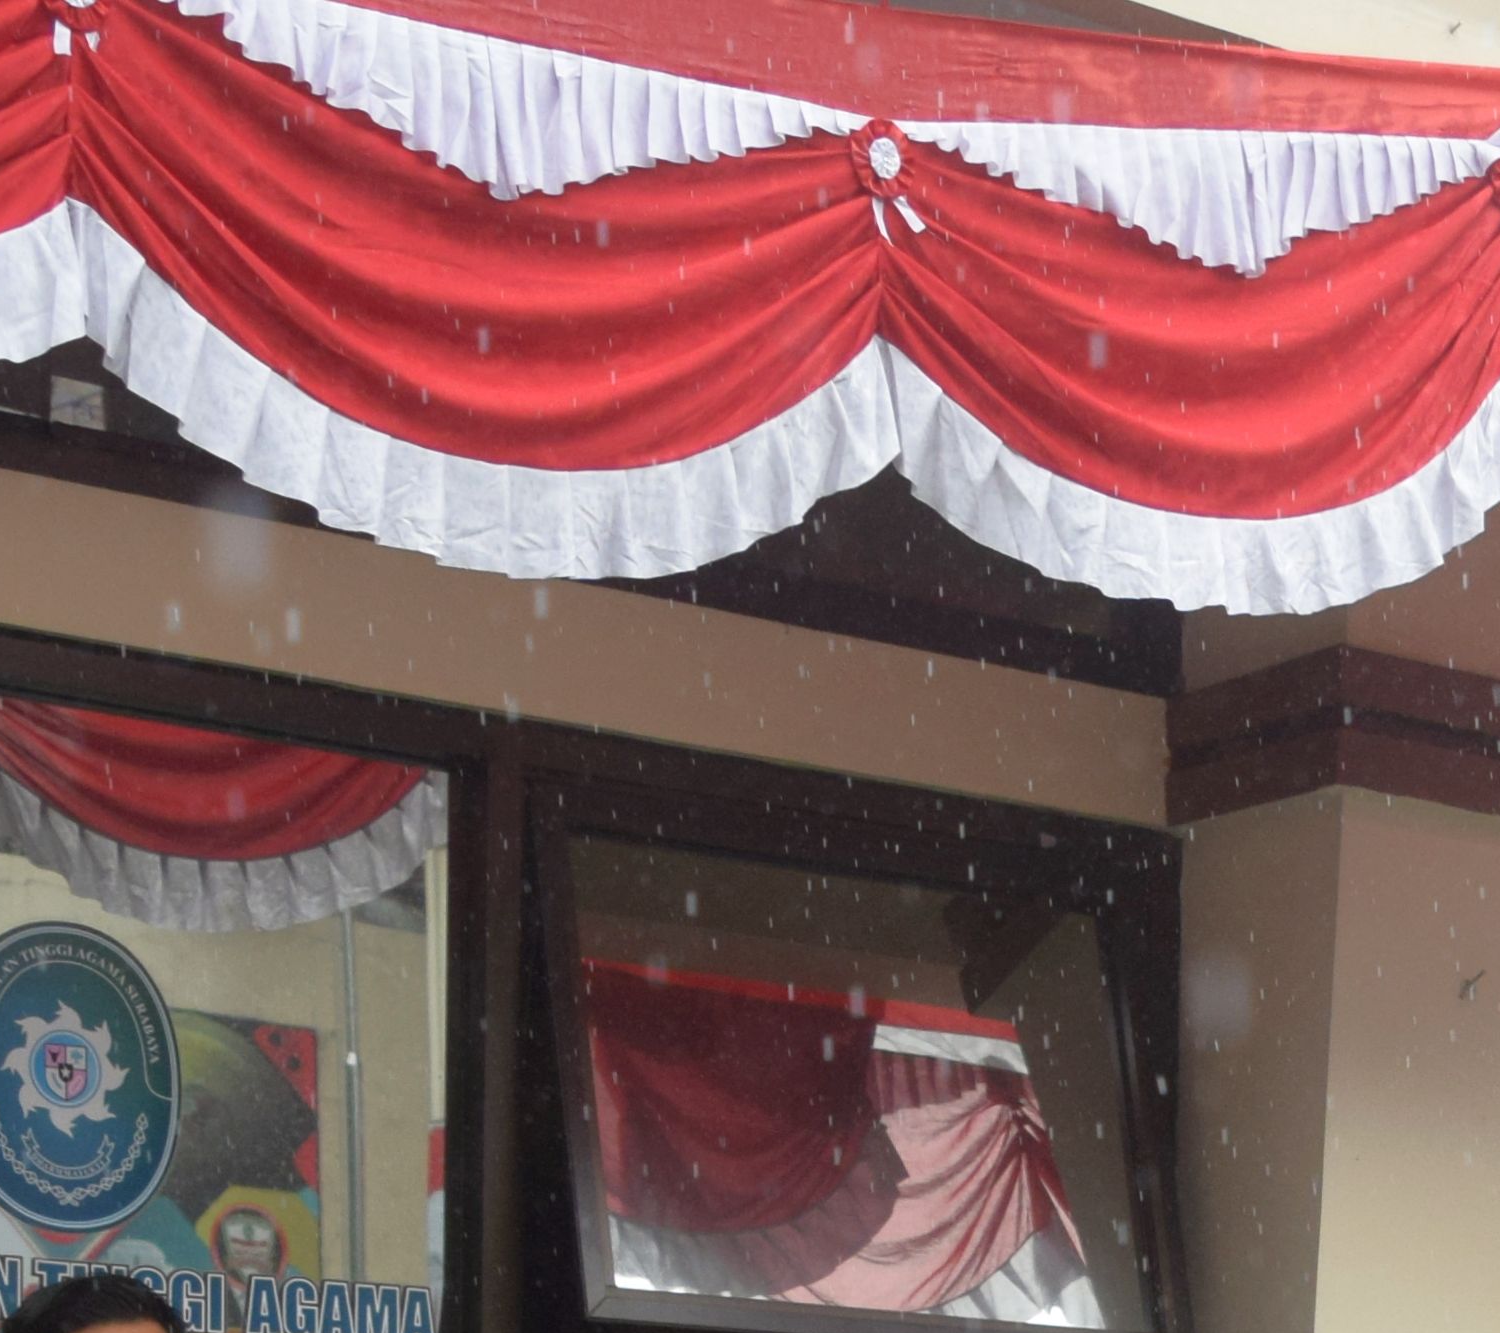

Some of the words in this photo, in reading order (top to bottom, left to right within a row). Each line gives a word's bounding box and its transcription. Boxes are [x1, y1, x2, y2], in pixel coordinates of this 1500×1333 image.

[20, 943, 73, 965] TINGGI
[76, 948, 128, 988] AGAMA
[125, 983, 161, 1065] SURABAYA
